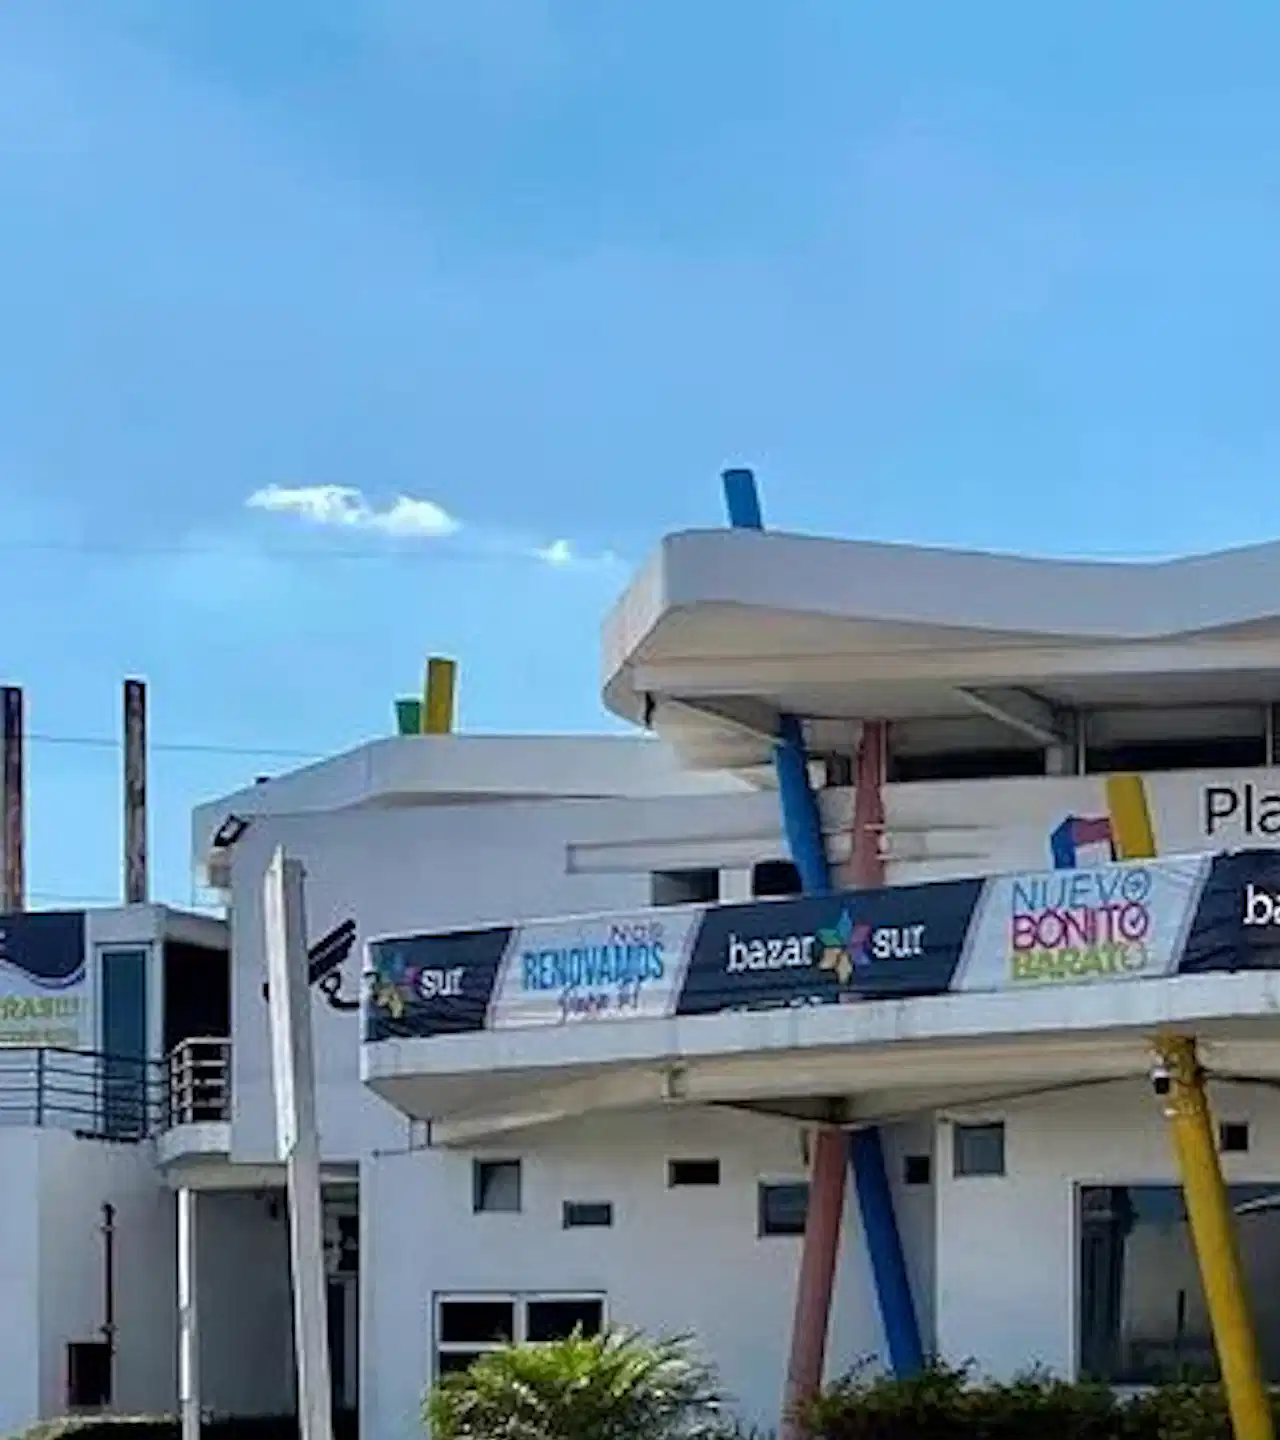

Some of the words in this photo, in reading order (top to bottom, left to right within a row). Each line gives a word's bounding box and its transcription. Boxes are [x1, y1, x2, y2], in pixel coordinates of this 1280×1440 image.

[1013, 868, 1152, 925] NUEVO
[726, 931, 818, 974] bazar
[871, 923, 926, 960] sur
[1013, 901, 1149, 950] BONITO
[420, 966, 464, 998] sur
[520, 942, 665, 990] RENOVAMOS
